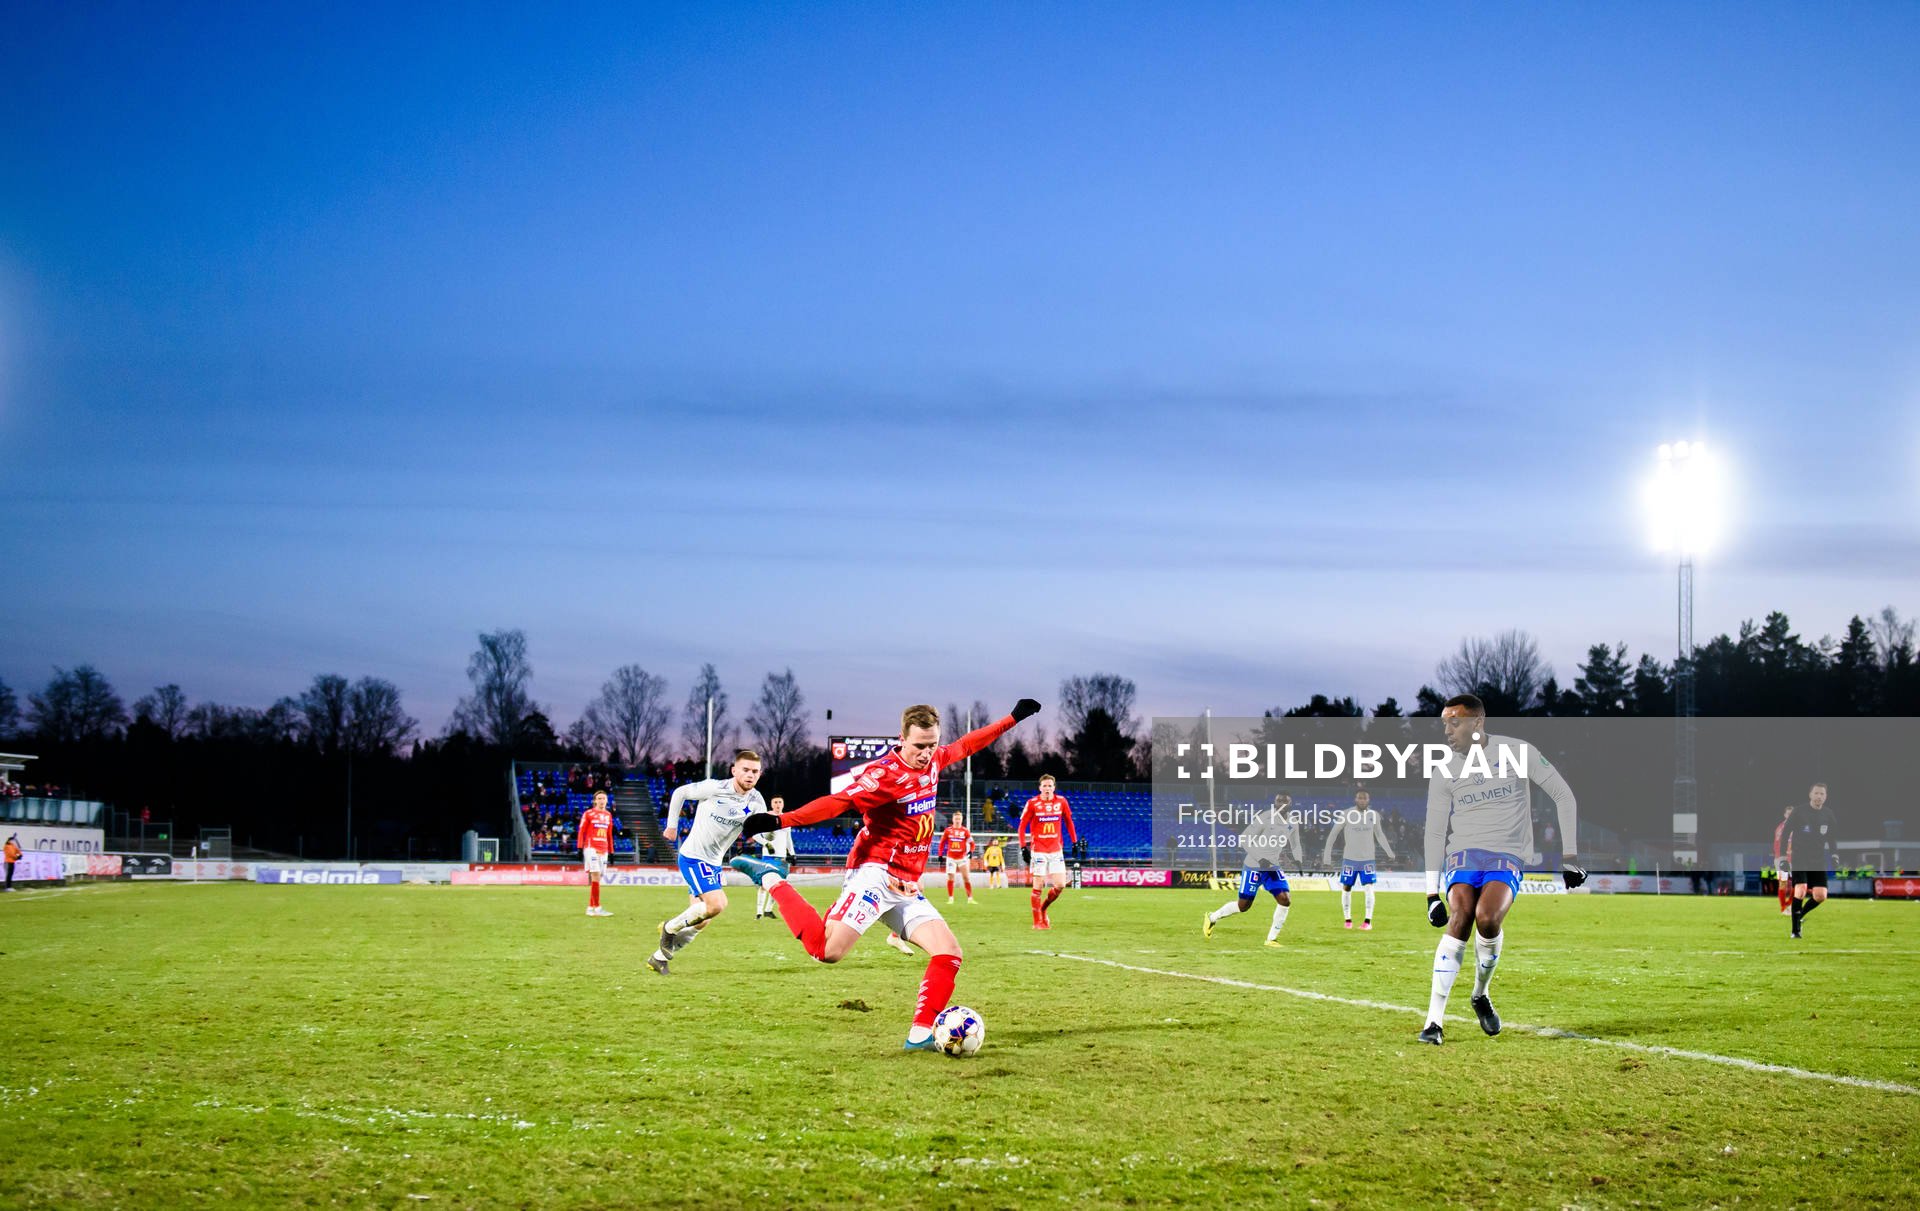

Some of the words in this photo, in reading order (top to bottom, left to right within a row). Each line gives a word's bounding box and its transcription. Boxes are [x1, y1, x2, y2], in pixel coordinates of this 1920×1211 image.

[1457, 784, 1513, 806] HOLMEN
[279, 869, 379, 884] Helmia
[1081, 869, 1168, 885] smarteyes
[854, 910, 866, 925] 12
